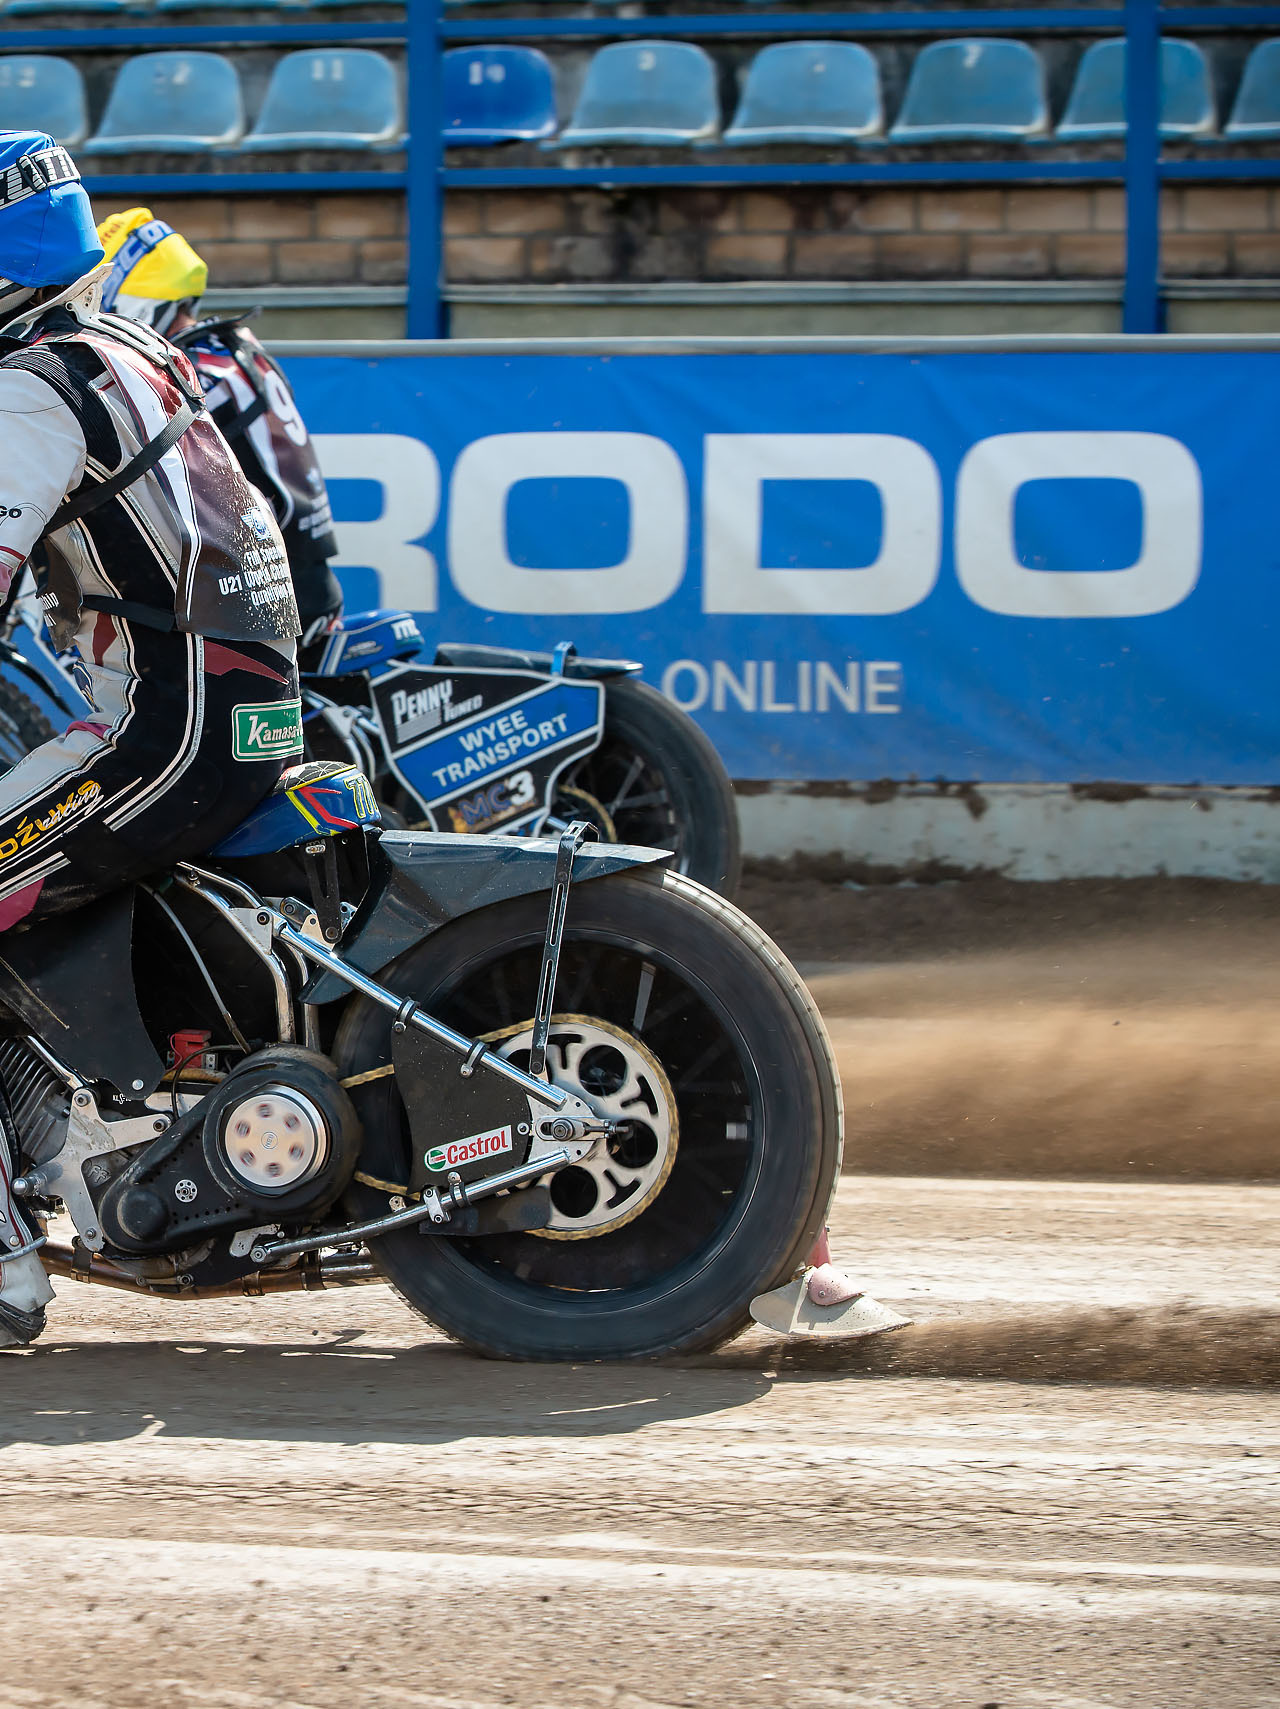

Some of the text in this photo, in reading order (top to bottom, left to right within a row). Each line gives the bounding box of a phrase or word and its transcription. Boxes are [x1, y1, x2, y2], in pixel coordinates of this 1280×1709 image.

[264, 370, 308, 446] 9
[314, 430, 1204, 618] RODO
[218, 574, 243, 596] U21
[391, 679, 453, 726] PENNY
[662, 658, 902, 715] ONLINE
[432, 713, 568, 787] TRANSPORT
[458, 709, 528, 752] WYEE
[447, 1130, 509, 1165] Castrol
